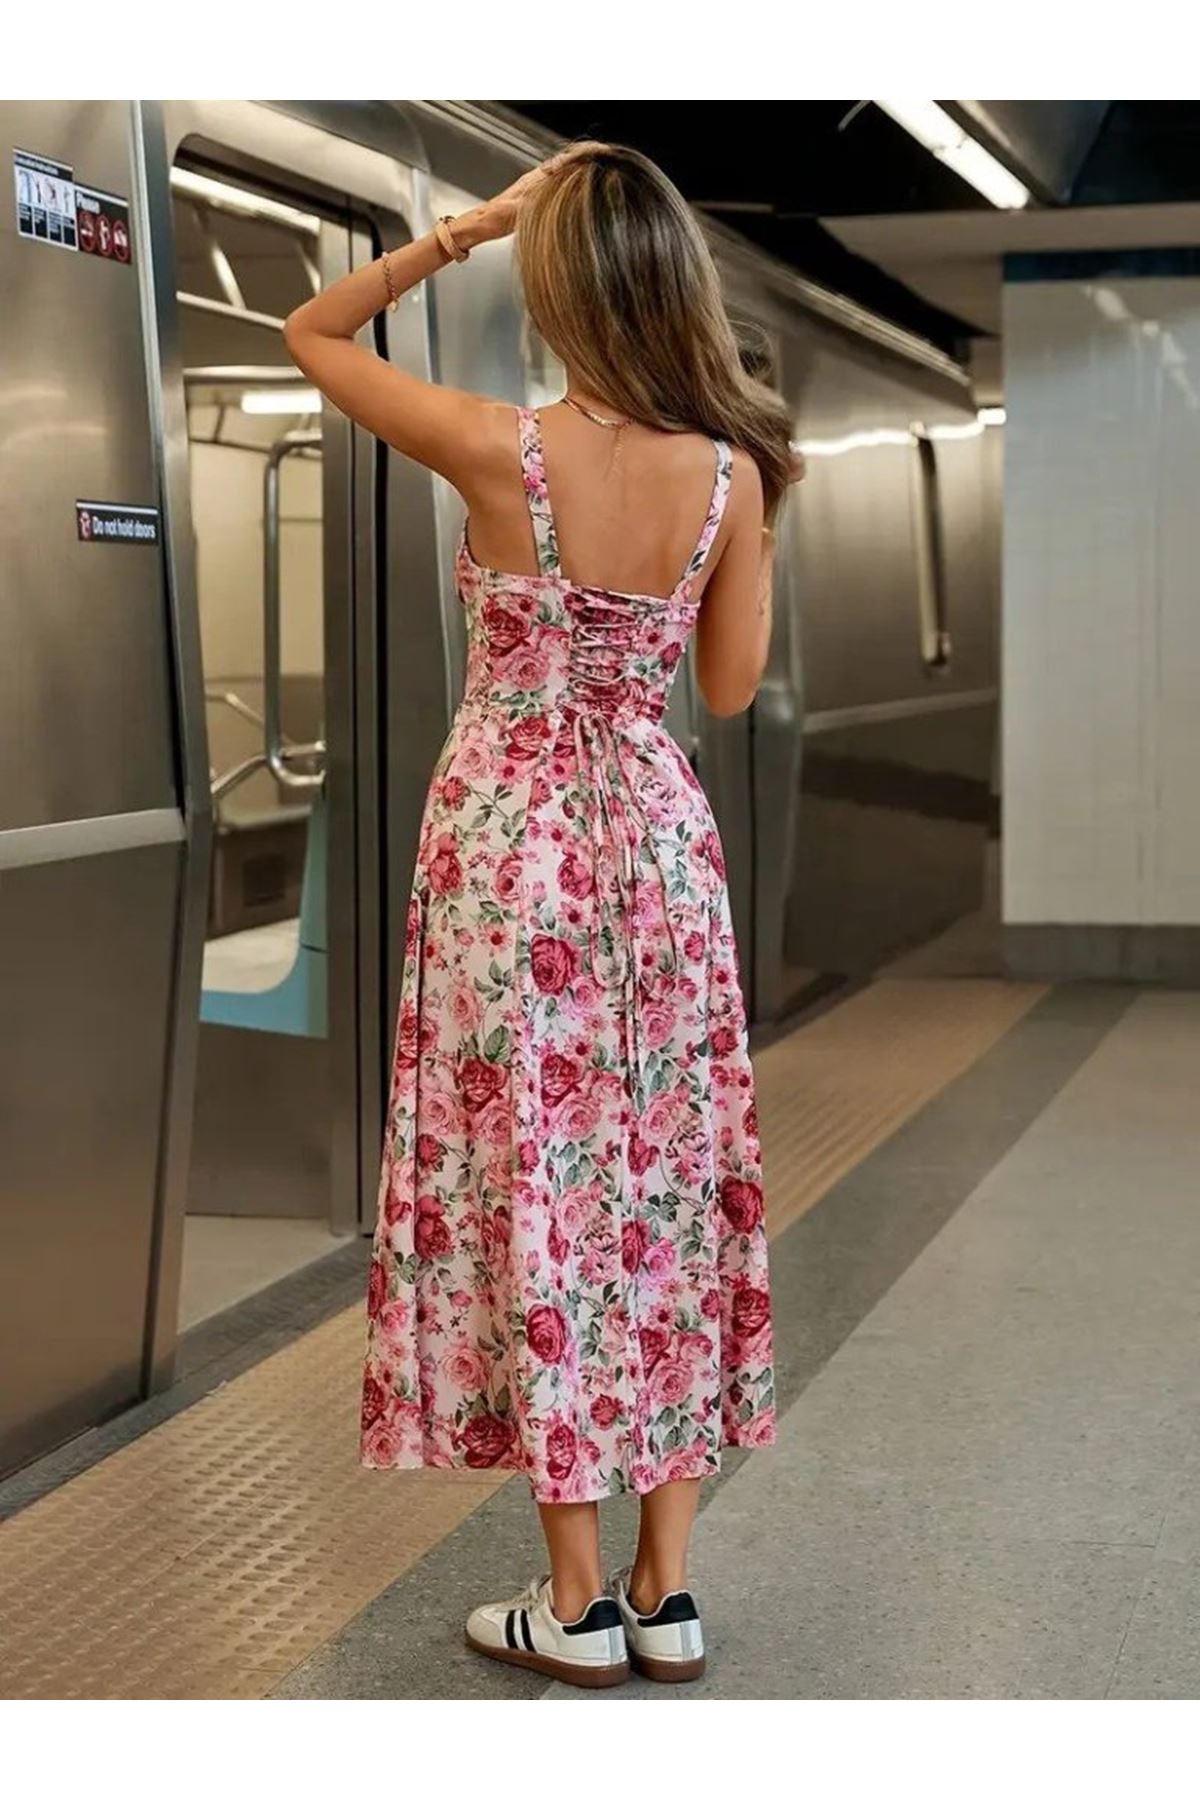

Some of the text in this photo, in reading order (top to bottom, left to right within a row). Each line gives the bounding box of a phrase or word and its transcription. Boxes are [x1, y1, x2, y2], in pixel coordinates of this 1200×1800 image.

[92, 516, 156, 538] Do not hold doors
